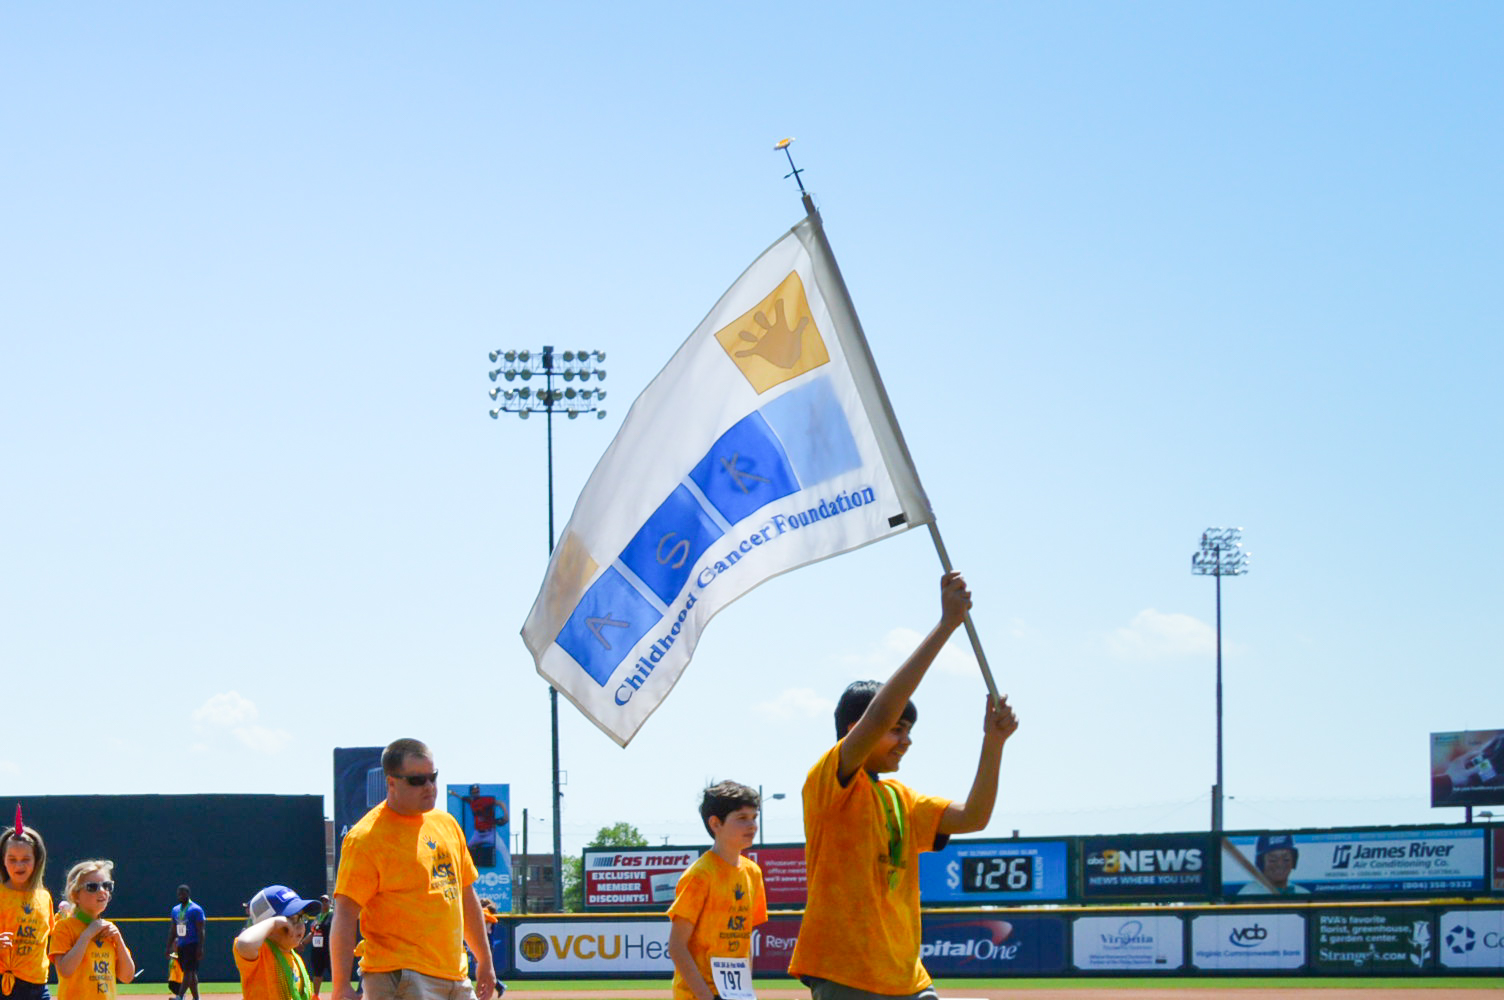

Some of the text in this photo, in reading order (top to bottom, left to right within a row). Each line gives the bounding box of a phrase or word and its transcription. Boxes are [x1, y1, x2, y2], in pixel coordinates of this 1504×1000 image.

[614, 486, 876, 706] Childhood Cancer Foundation
[1353, 842, 1454, 860] James River
[645, 854, 690, 866] mart
[1353, 859, 1449, 869] Air Conditioning Co.
[592, 871, 646, 880] EXCLUSIVE
[1089, 875, 1201, 885] NEWS WHERE YOU LIVE
[597, 883, 641, 891] MEMBER
[589, 894, 649, 903] DISCOUNTS!
[1349, 915, 1386, 924] favorite
[766, 936, 797, 948] Reyn
[1329, 935, 1364, 944] garden
[550, 934, 672, 959] VCU Hea
[720, 971, 742, 990] 797
